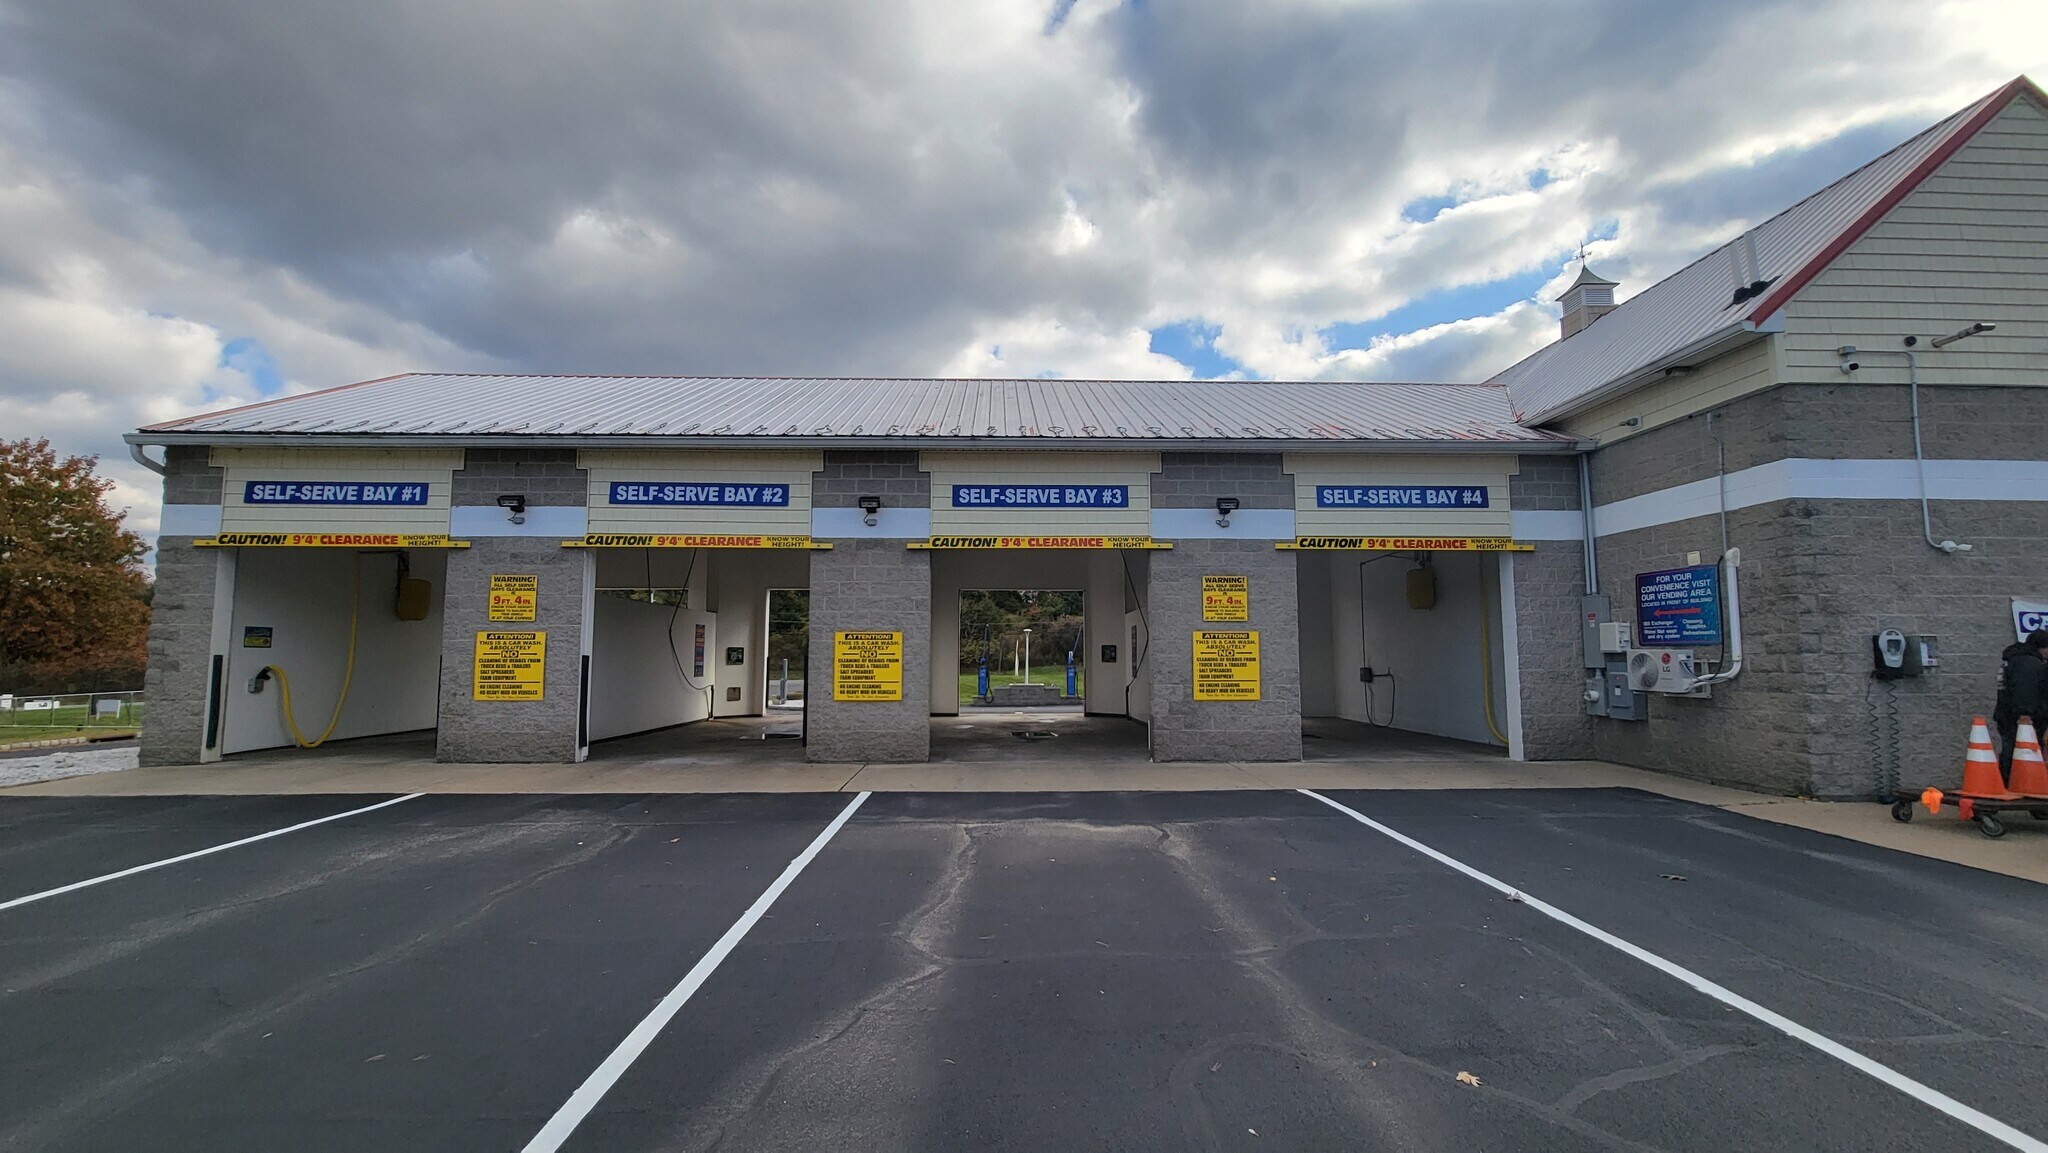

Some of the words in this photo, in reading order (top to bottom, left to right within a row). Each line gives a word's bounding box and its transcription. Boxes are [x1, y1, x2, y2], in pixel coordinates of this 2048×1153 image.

[252, 484, 358, 501] SELF-SERVE
[363, 484, 398, 501] BAY
[402, 484, 421, 501] #1
[617, 486, 719, 502] SELF-SERVE
[725, 486, 757, 502] BAY
[762, 486, 782, 502] #2
[959, 488, 1060, 504] SELF-SERVE
[1065, 488, 1097, 504] BAY
[1102, 488, 1122, 504] #3
[1323, 490, 1421, 504] SELF-SERVE
[1427, 490, 1457, 504] BAY
[1462, 490, 1482, 504] #4
[218, 534, 287, 545] CAUTION!
[320, 535, 398, 545] CLEARANCE
[586, 536, 653, 546] CAUTION!
[684, 537, 761, 546] CLEARANCE
[932, 538, 997, 547] CAUTION!
[1028, 538, 1103, 547] CLEARANCE
[1300, 538, 1362, 548] CAUTION!
[1393, 540, 1467, 549] CLEARANCE
[1641, 582, 1689, 593] CONVENIENCE
[1692, 579, 1710, 587] VISIT
[494, 596, 500, 604] 9
[515, 596, 522, 604] 4
[1207, 596, 1213, 604] 9
[1227, 596, 1233, 604] 4
[1658, 591, 1687, 599] VENDING
